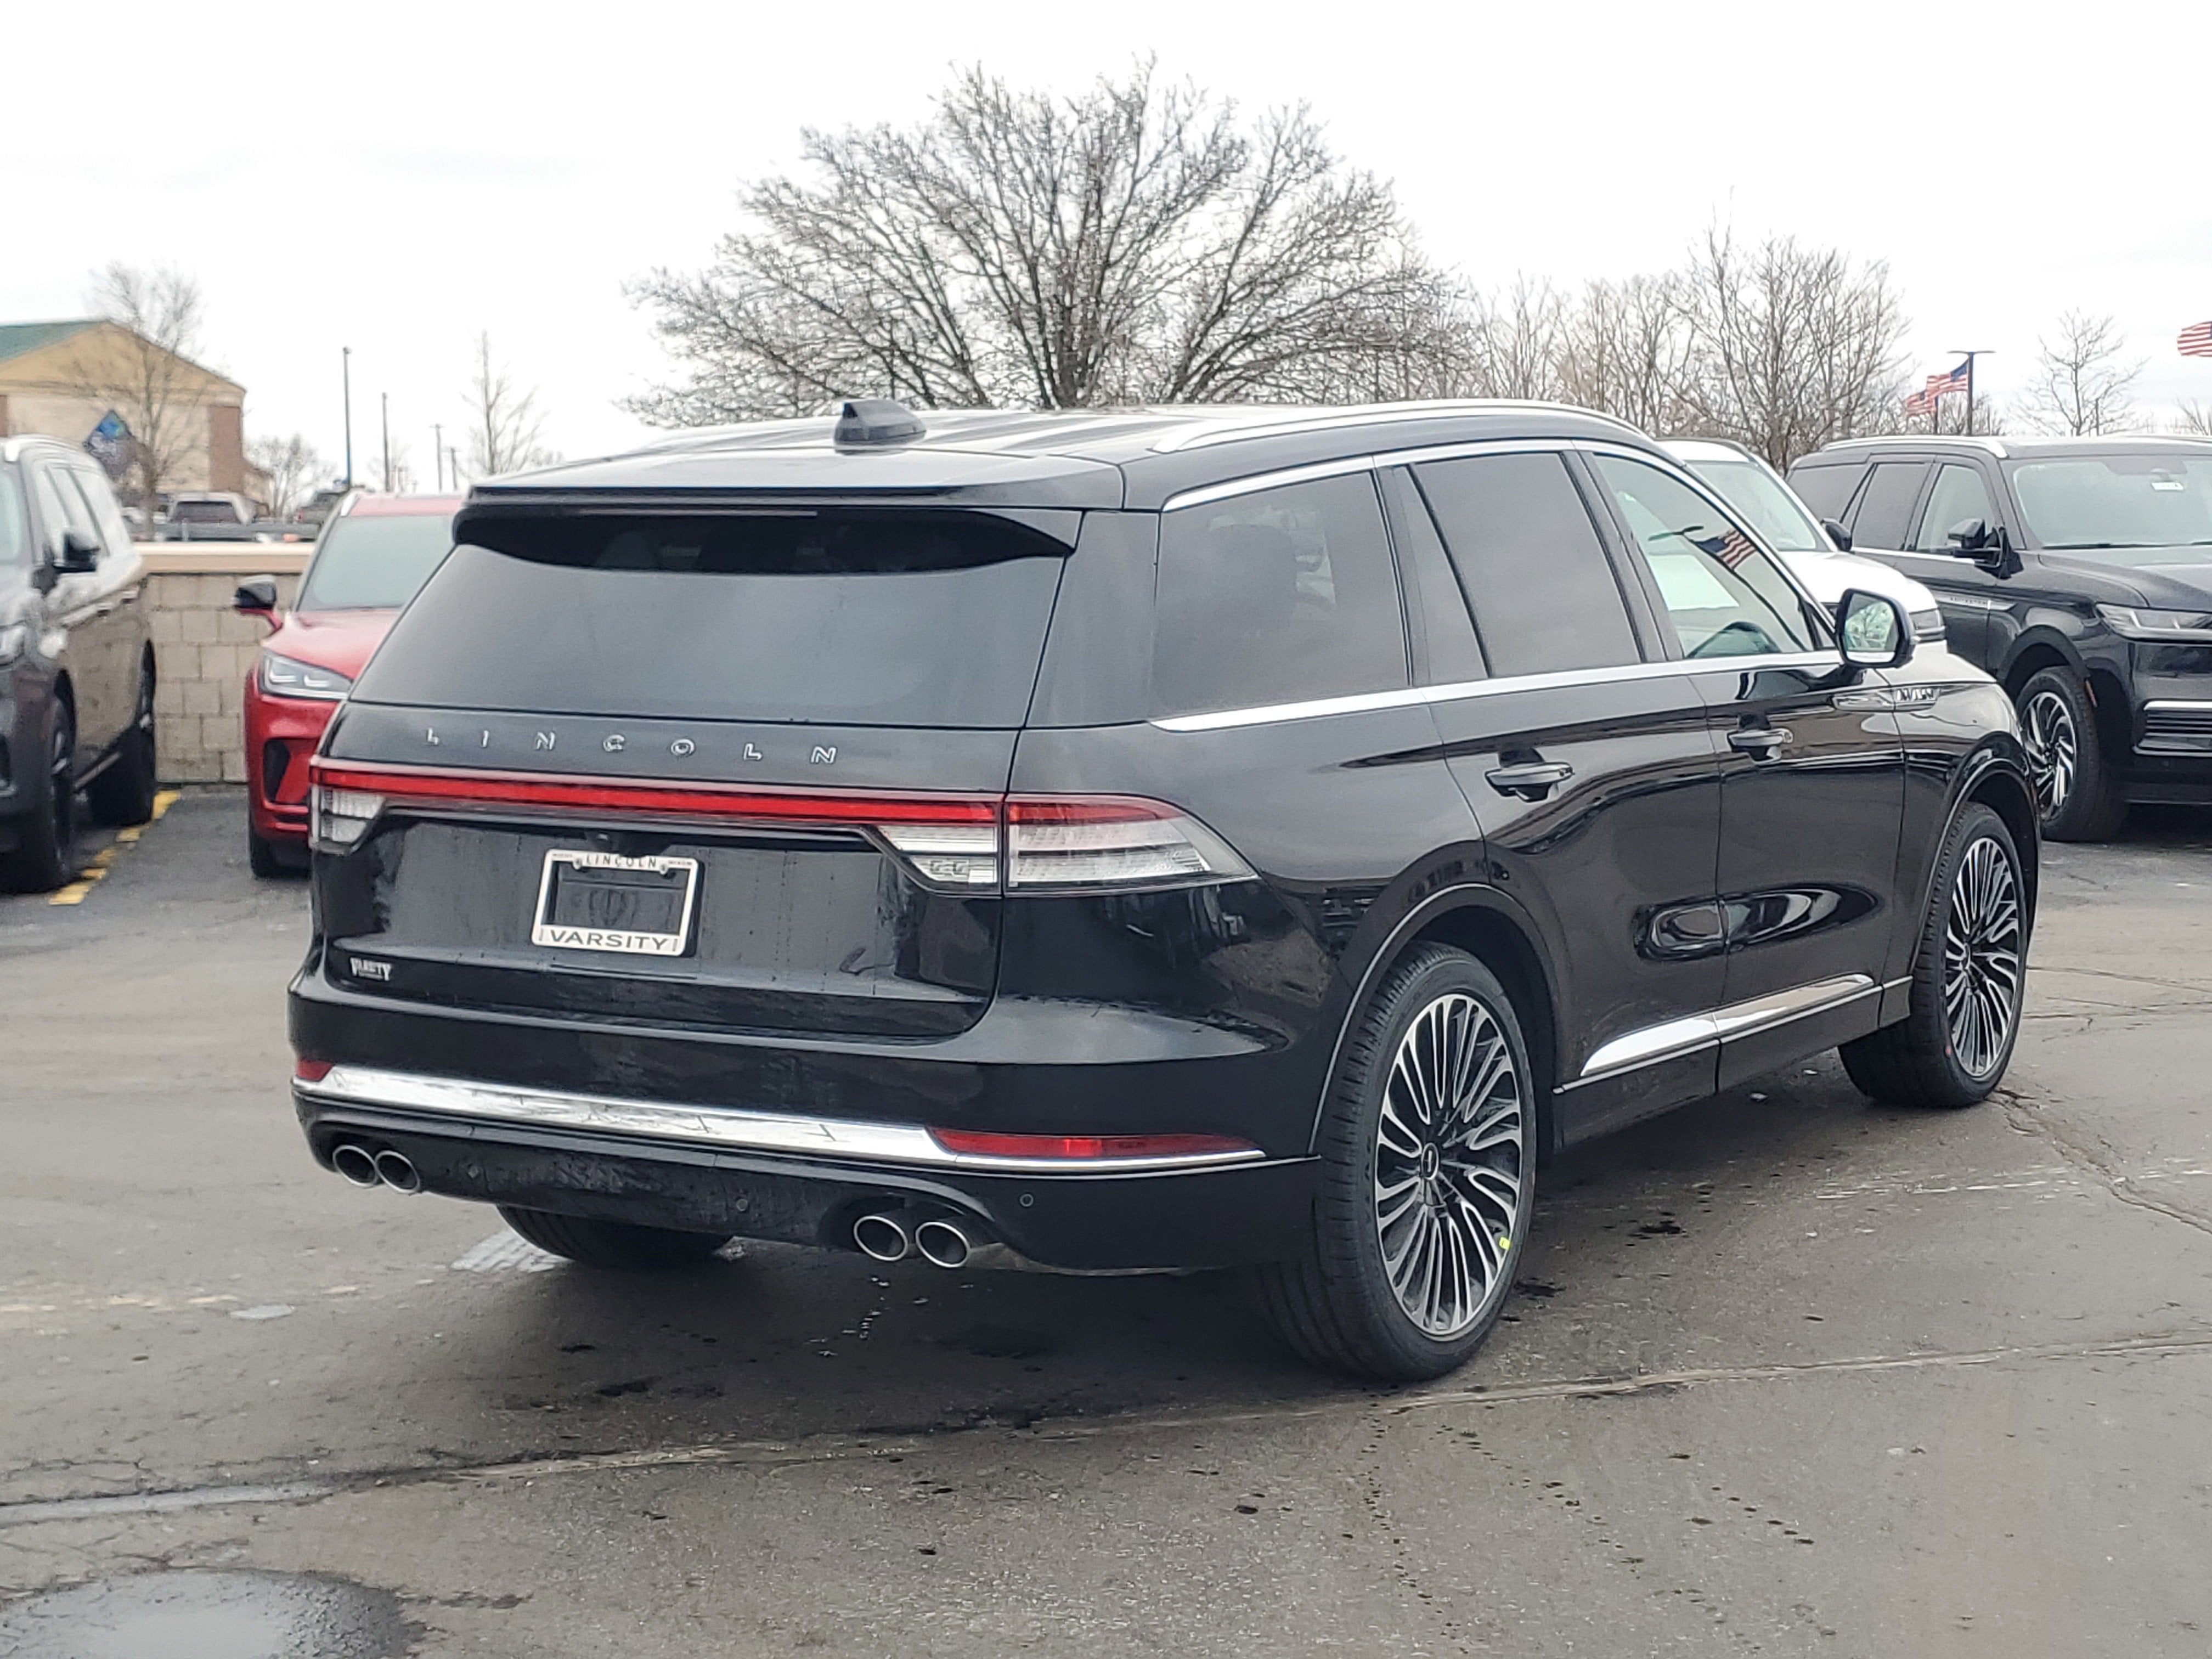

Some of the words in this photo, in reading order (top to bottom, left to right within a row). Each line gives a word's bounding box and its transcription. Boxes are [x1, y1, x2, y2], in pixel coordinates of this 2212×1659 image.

[425, 727, 837, 765] LINCOLN
[585, 855, 657, 868] LINCOLN
[550, 929, 669, 951] VARSITY
